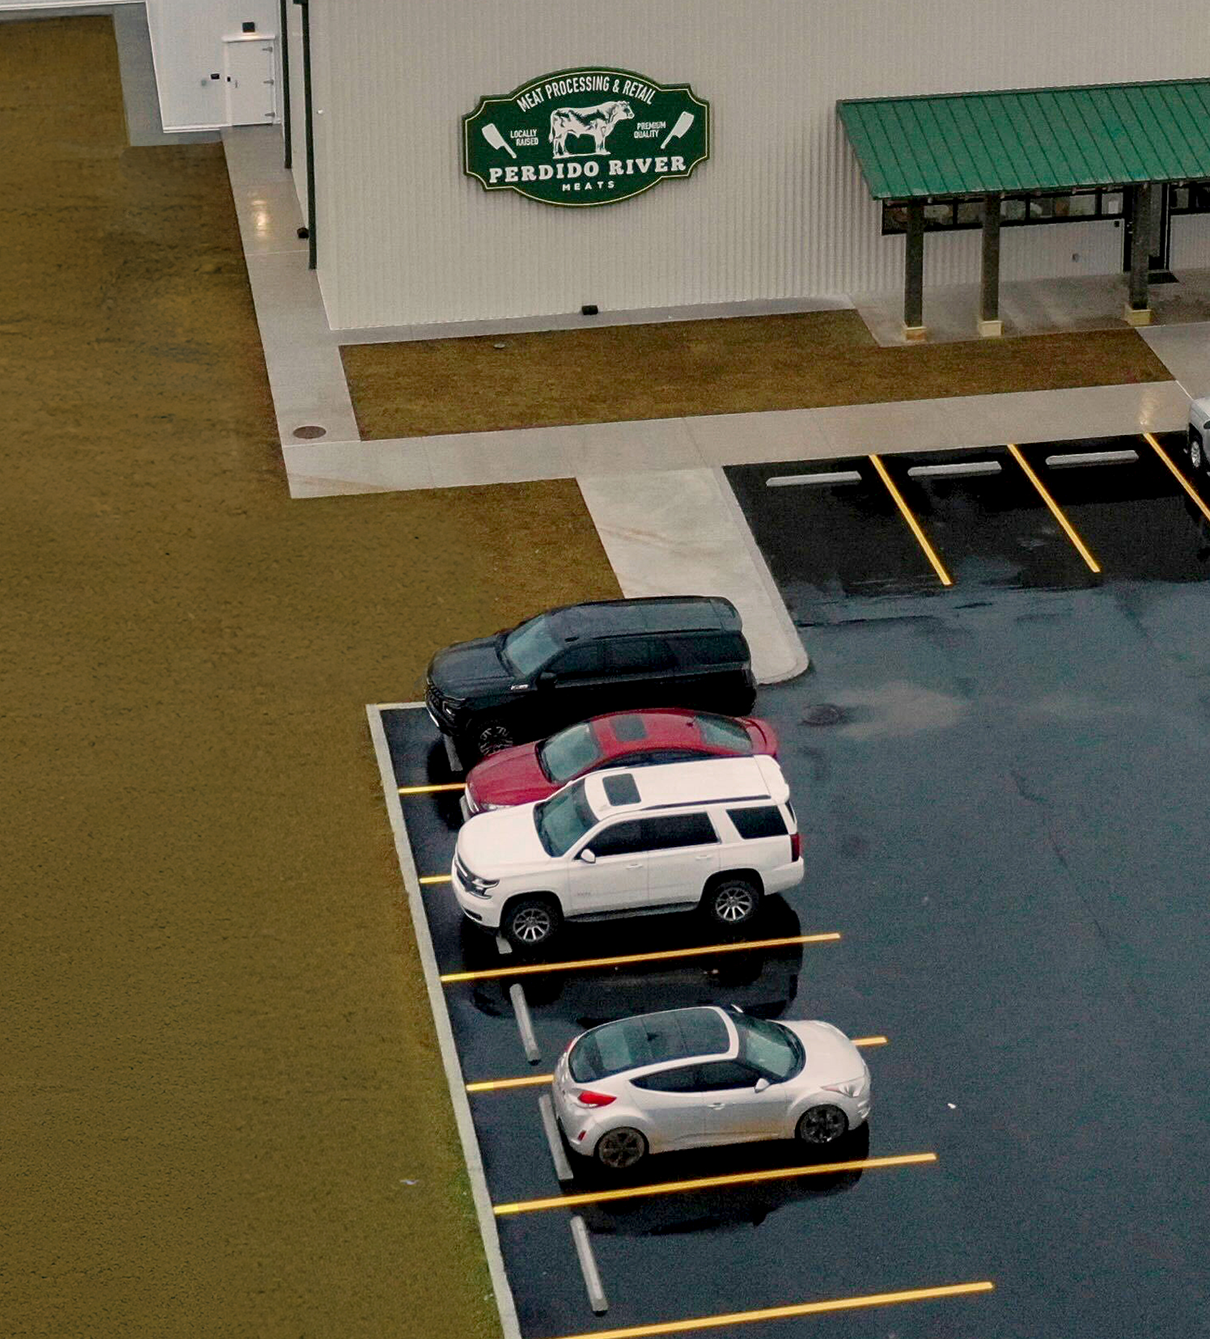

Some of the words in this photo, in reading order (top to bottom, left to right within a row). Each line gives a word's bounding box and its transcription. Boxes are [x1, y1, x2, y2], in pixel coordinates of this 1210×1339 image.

[516, 88, 545, 113] MEAT
[545, 76, 610, 100] PROCESSING
[612, 79, 620, 94] &
[622, 79, 656, 105] RETAIL
[637, 121, 667, 130] PREMIUM
[510, 128, 538, 139] LOCALLY
[633, 130, 660, 139] QUALITY
[516, 137, 539, 147] RAISED
[489, 161, 600, 183] PERDIDO
[608, 156, 686, 176] RIVER
[562, 180, 615, 191] MEATS
